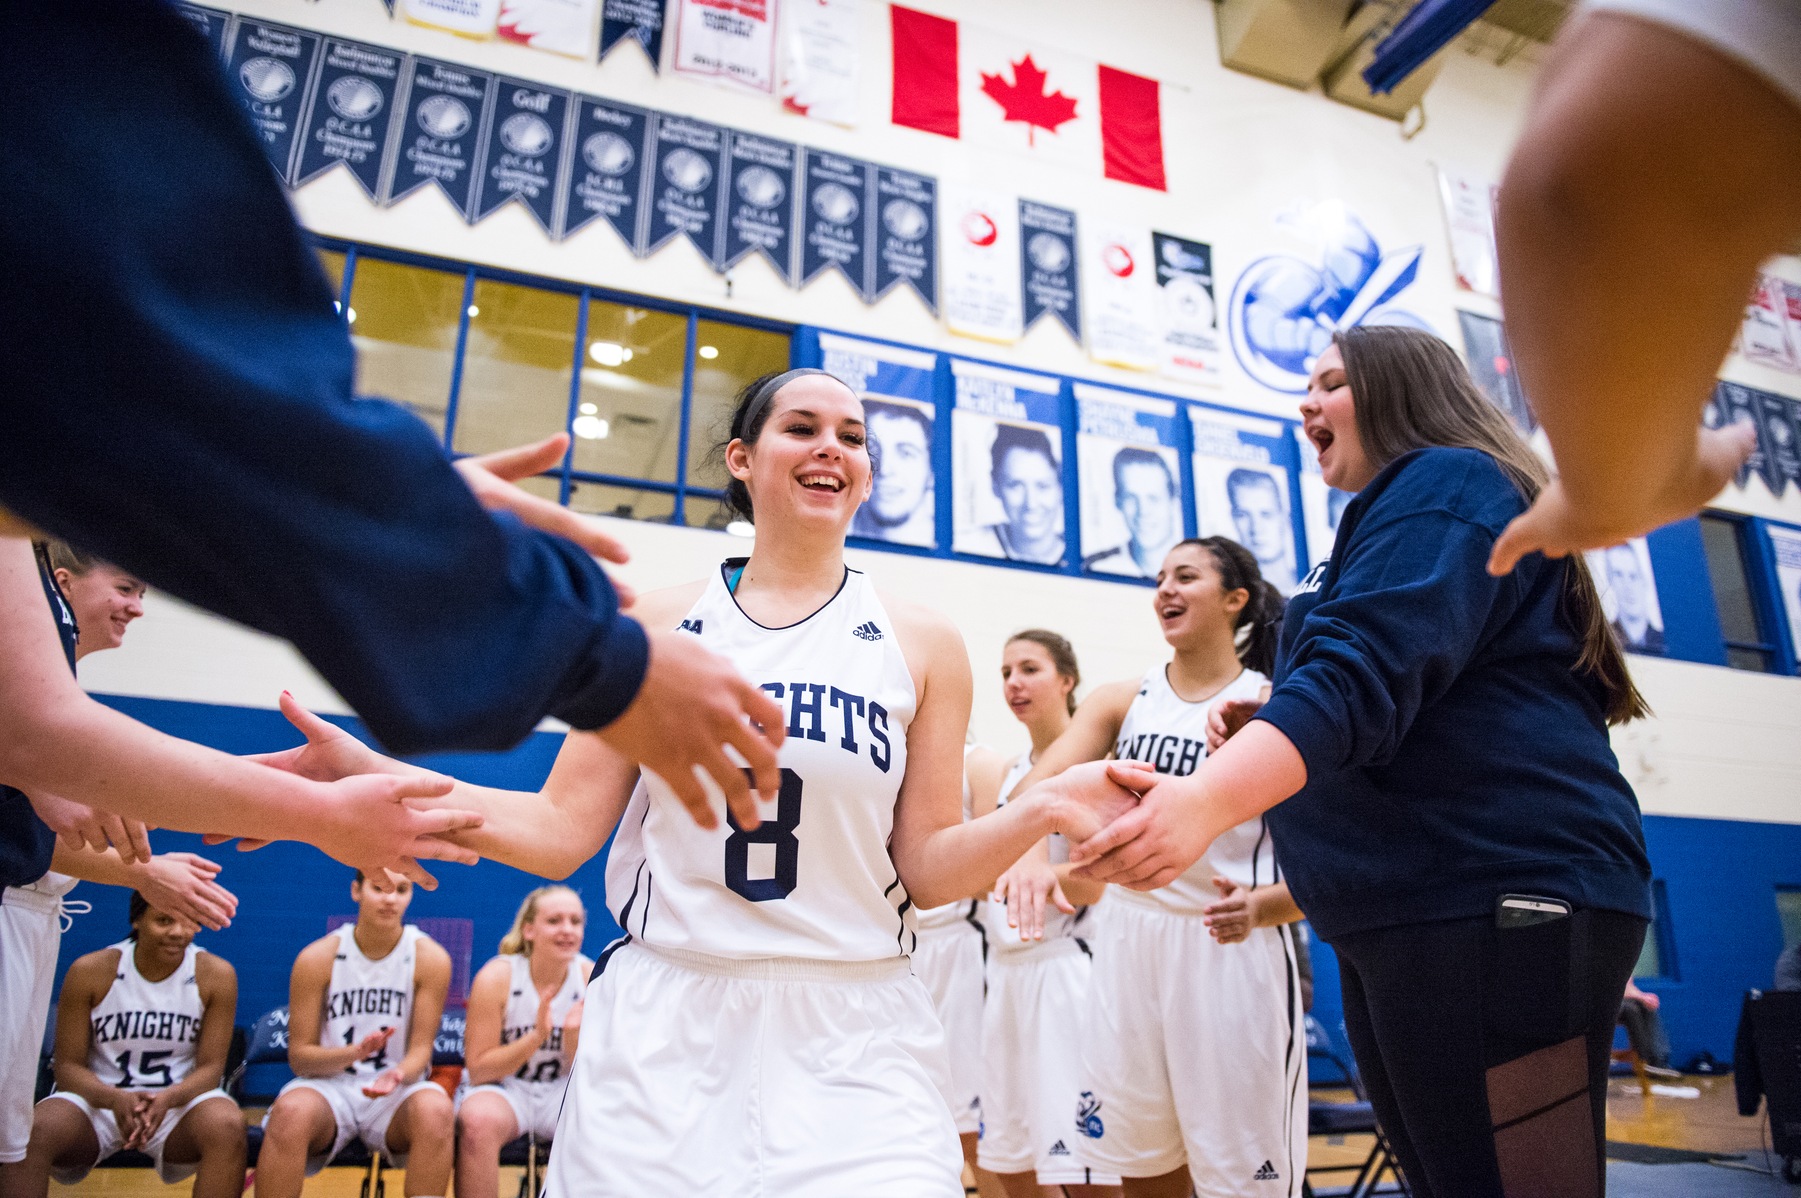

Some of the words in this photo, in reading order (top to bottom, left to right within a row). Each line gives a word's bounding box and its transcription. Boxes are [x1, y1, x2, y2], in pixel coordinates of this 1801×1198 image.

[512, 88, 552, 113] Golf
[757, 682, 891, 774] GHTS
[725, 767, 803, 902] 8
[94, 1011, 201, 1043] KNIGHTS
[115, 1050, 174, 1088] 15
